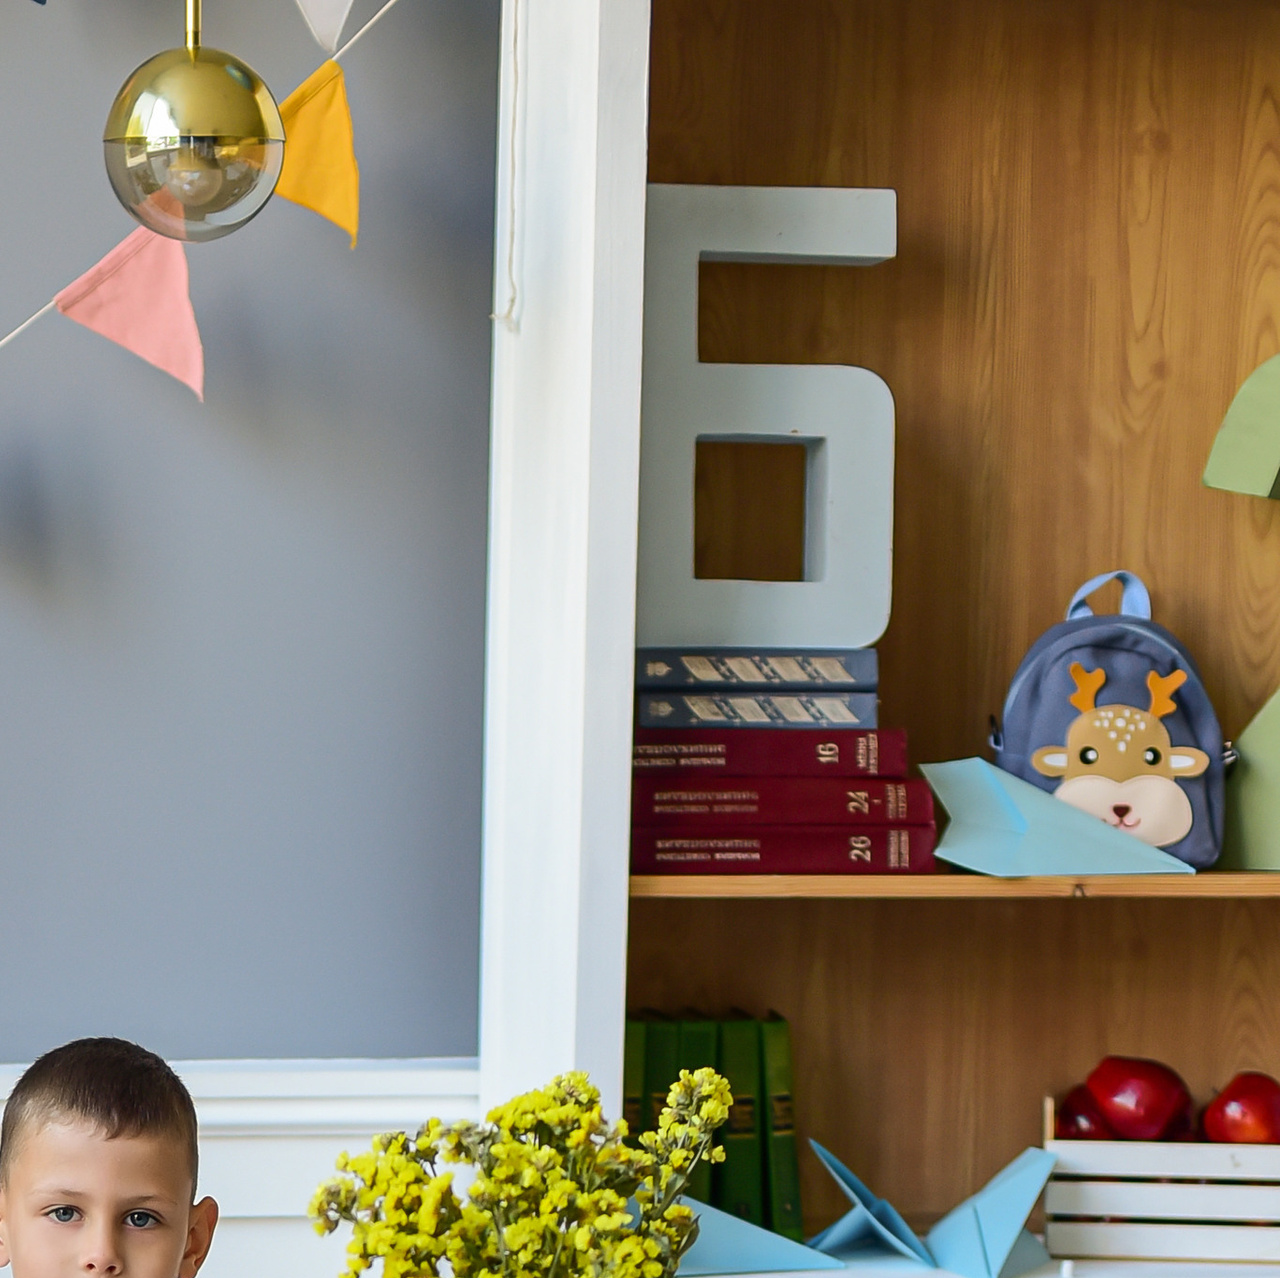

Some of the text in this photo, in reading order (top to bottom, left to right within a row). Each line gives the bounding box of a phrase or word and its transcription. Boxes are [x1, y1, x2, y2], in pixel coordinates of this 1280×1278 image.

[637, 183, 898, 650] Б
[815, 742, 839, 764] 16
[846, 790, 870, 815] 24
[848, 835, 872, 863] 26
